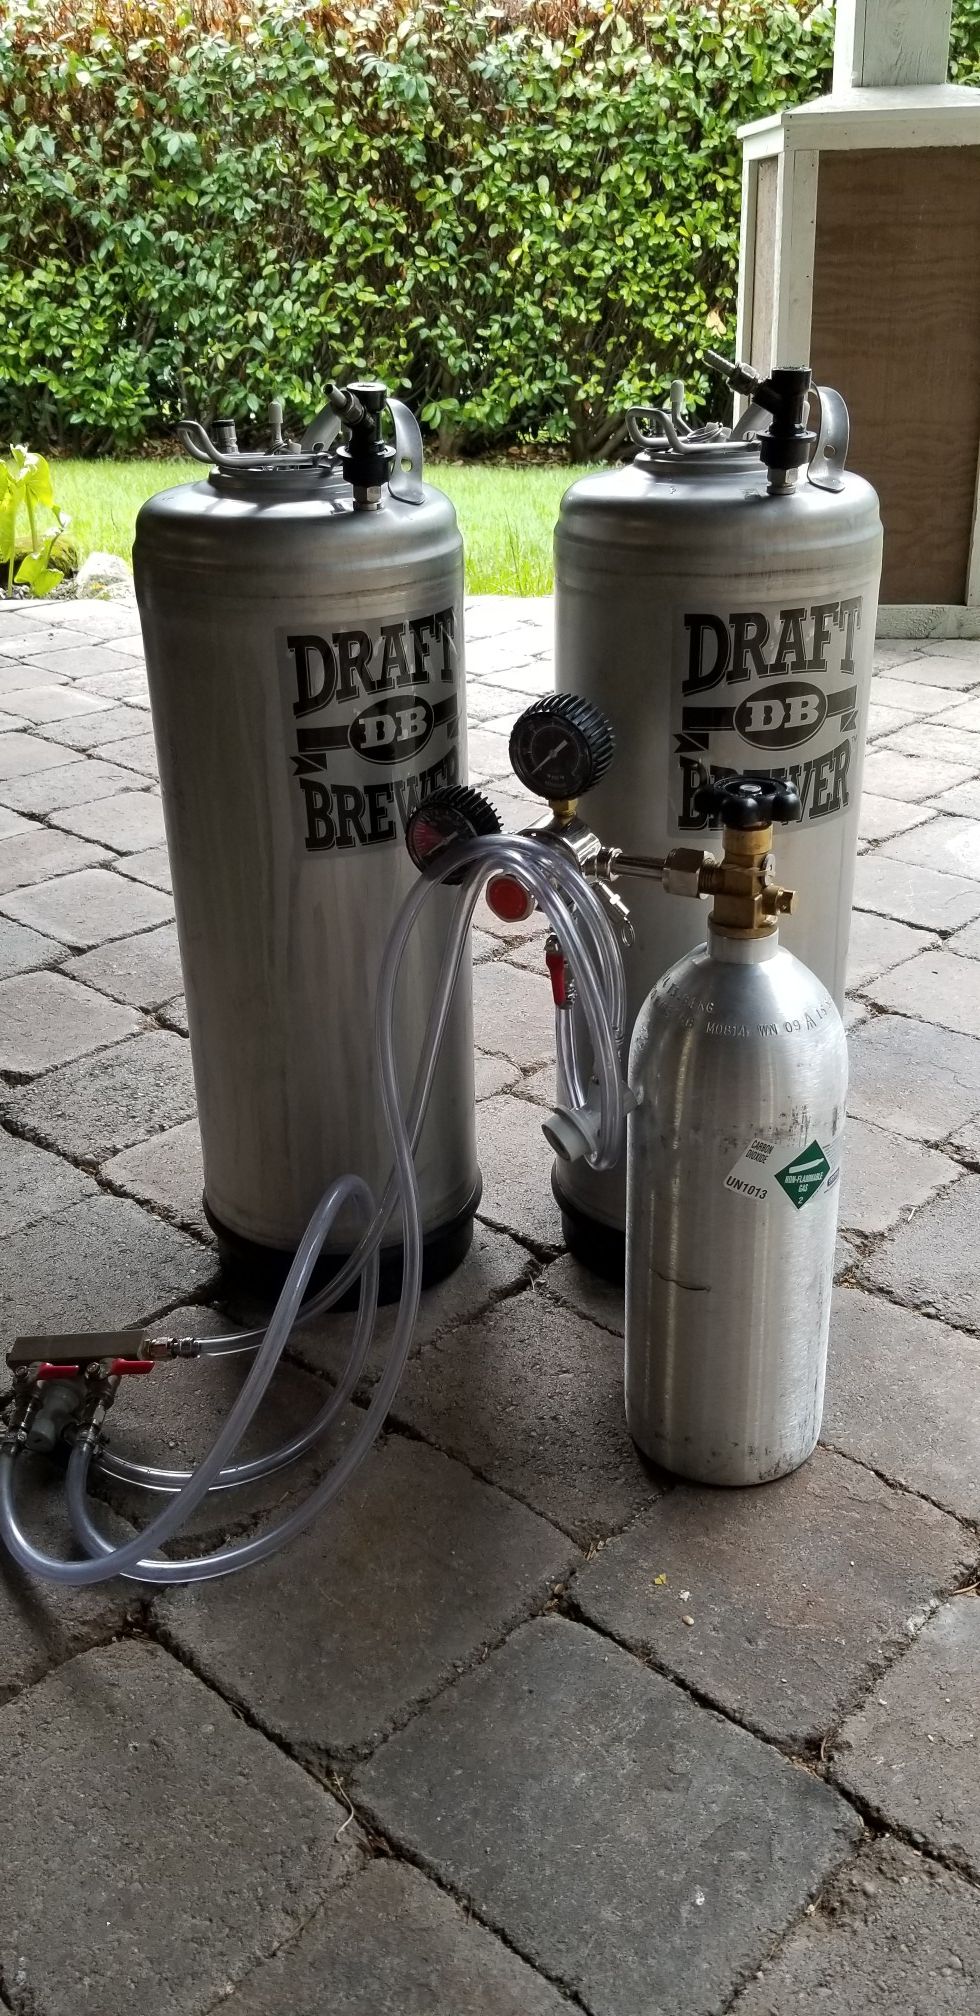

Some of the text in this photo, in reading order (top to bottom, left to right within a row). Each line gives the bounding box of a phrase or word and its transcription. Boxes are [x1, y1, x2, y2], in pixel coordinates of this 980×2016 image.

[681, 596, 863, 697] DRAFT
[287, 606, 457, 719] DRAFT
[744, 693, 820, 733] DB
[358, 704, 428, 749] DB
[678, 738, 852, 831] BWER
[784, 1019, 801, 1033] 09
[745, 1149, 769, 1164] DIOXIDE
[750, 1139, 775, 1155] CARBON
[726, 1175, 768, 1200] UN1013
[784, 1171, 824, 1184] NON-FLAMMABLE
[798, 1183, 809, 1193] GAS
[797, 1196, 804, 1204] 2
